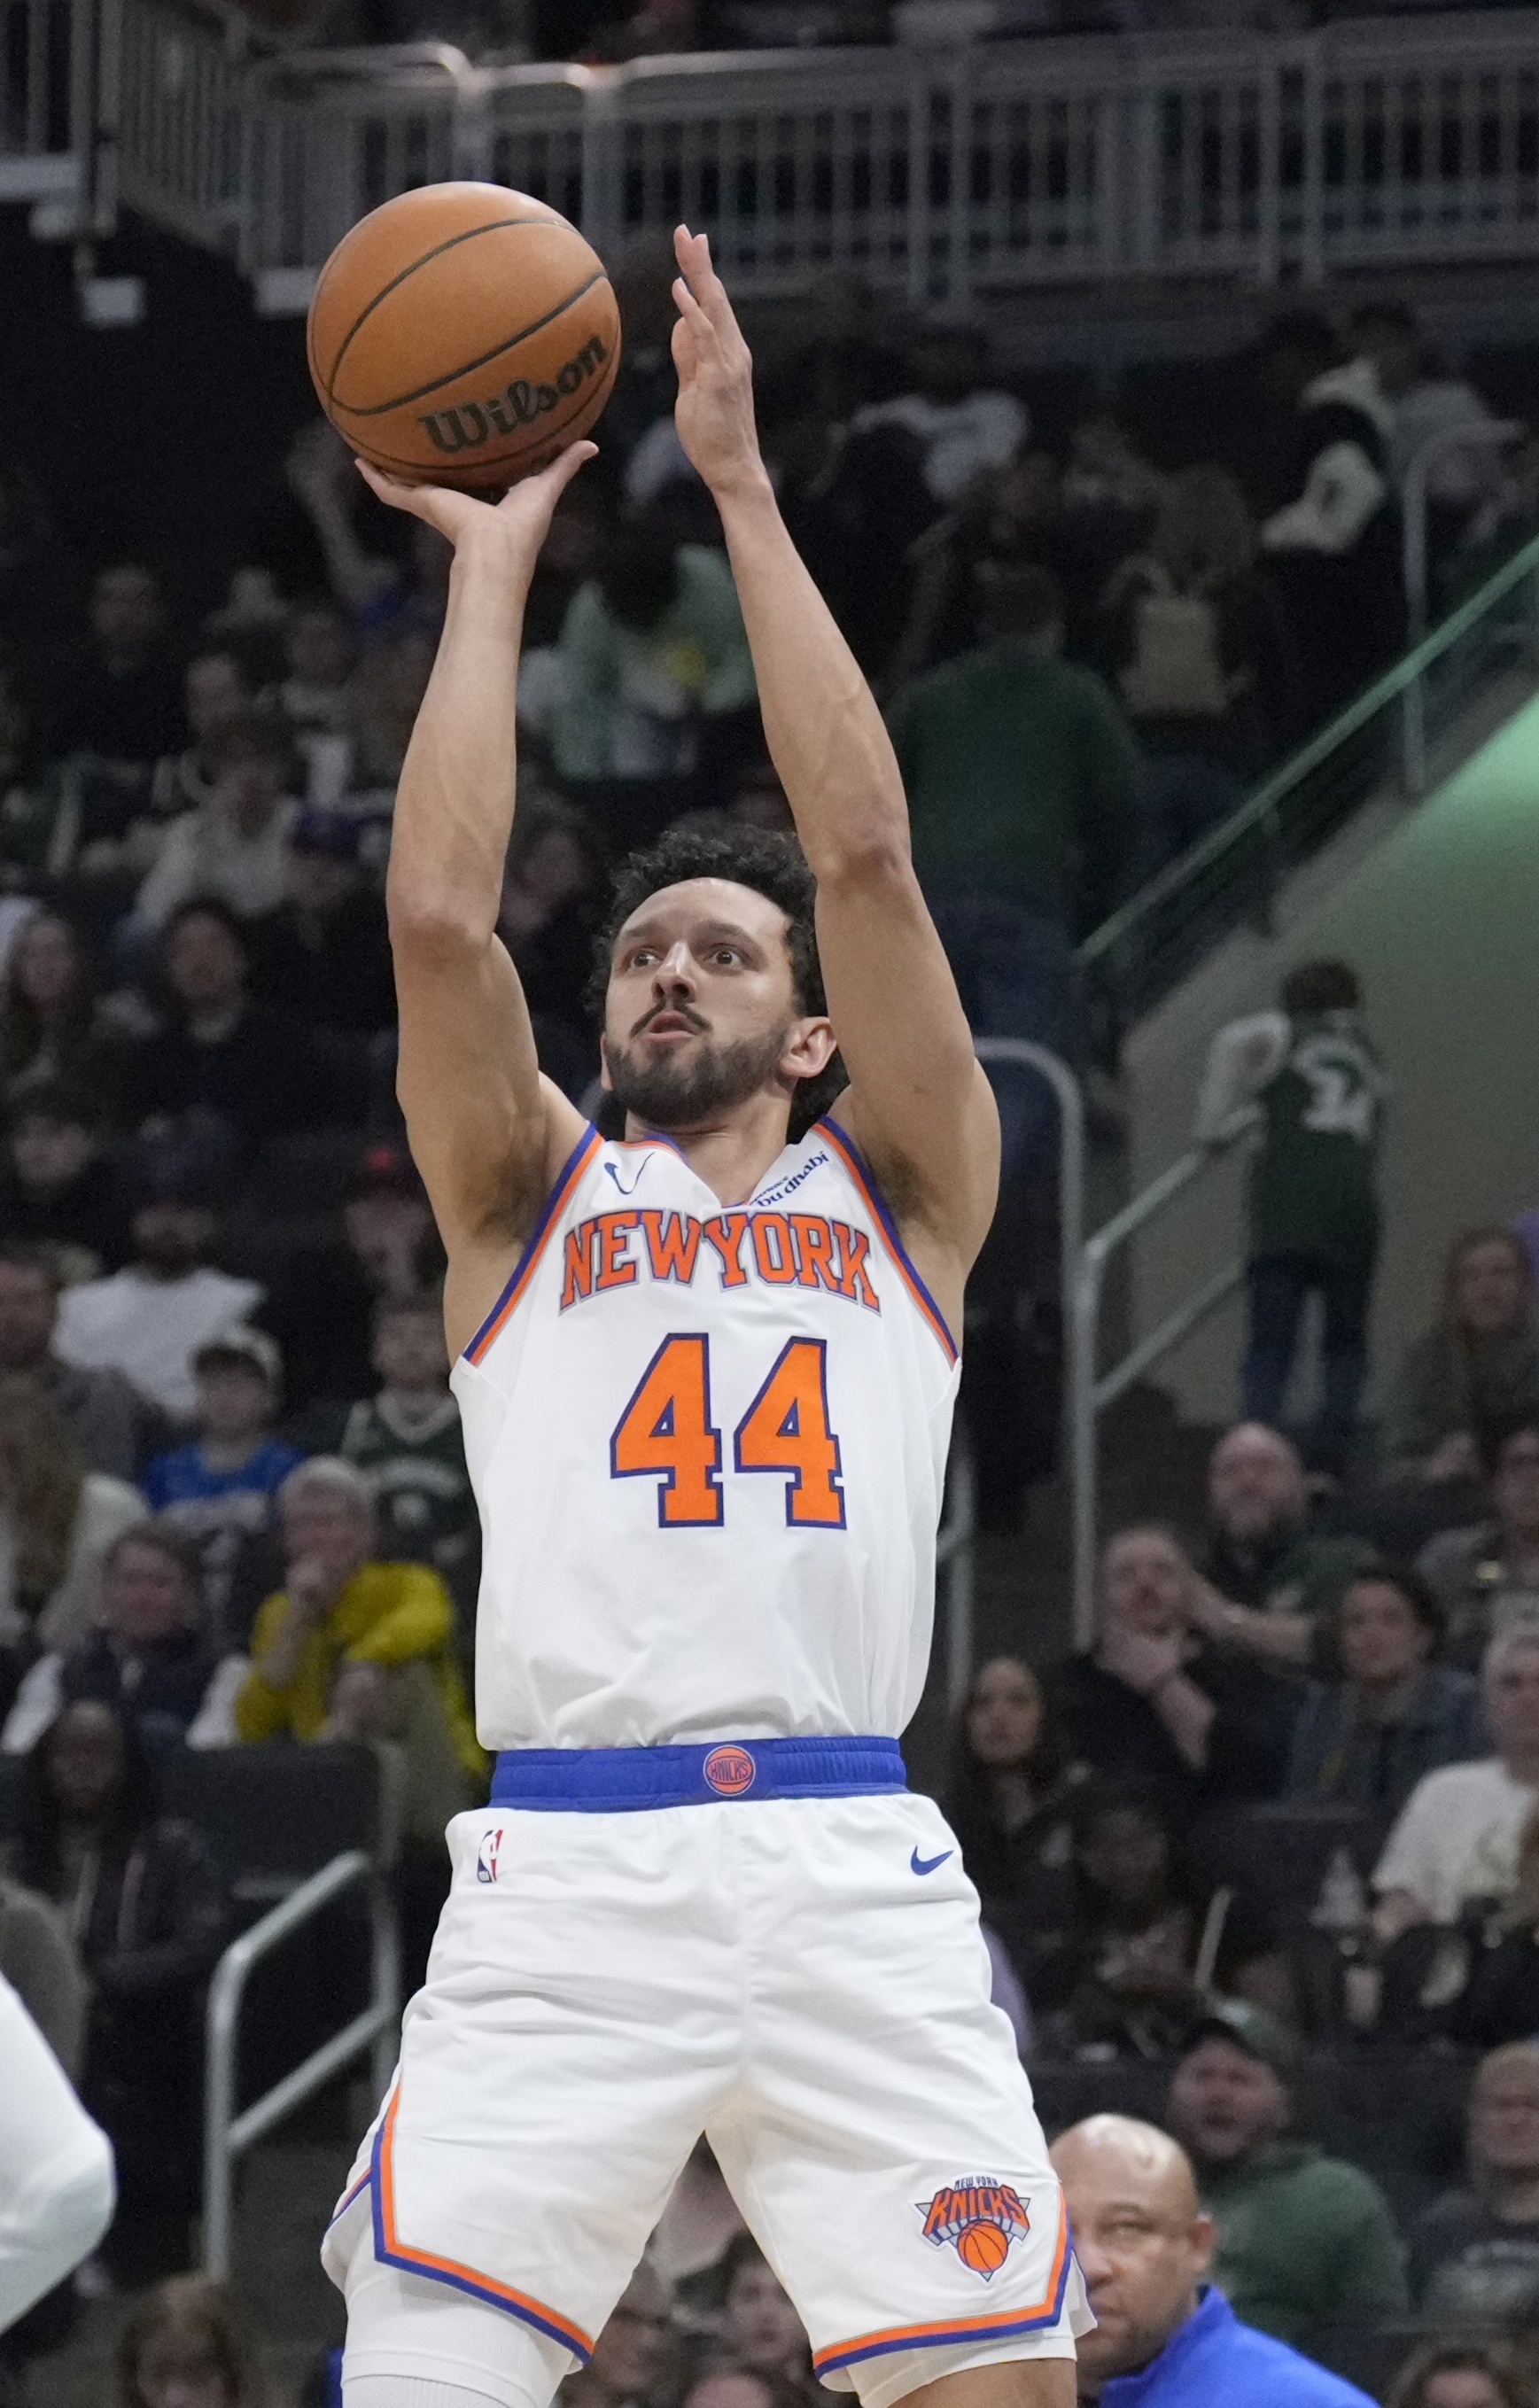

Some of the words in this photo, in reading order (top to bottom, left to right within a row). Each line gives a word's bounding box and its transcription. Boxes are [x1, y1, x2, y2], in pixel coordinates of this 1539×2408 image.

[417, 336, 607, 454] Wilson
[757, 1192, 783, 1207] bu
[784, 1151, 829, 1193] dhabi
[558, 1208, 702, 1314] NEW
[702, 1211, 881, 1315] YORK
[610, 1332, 847, 1530] 44
[922, 2185, 1030, 2239] KNICKS
[954, 2176, 974, 2191] NEW
[975, 2176, 999, 2188] YORK
